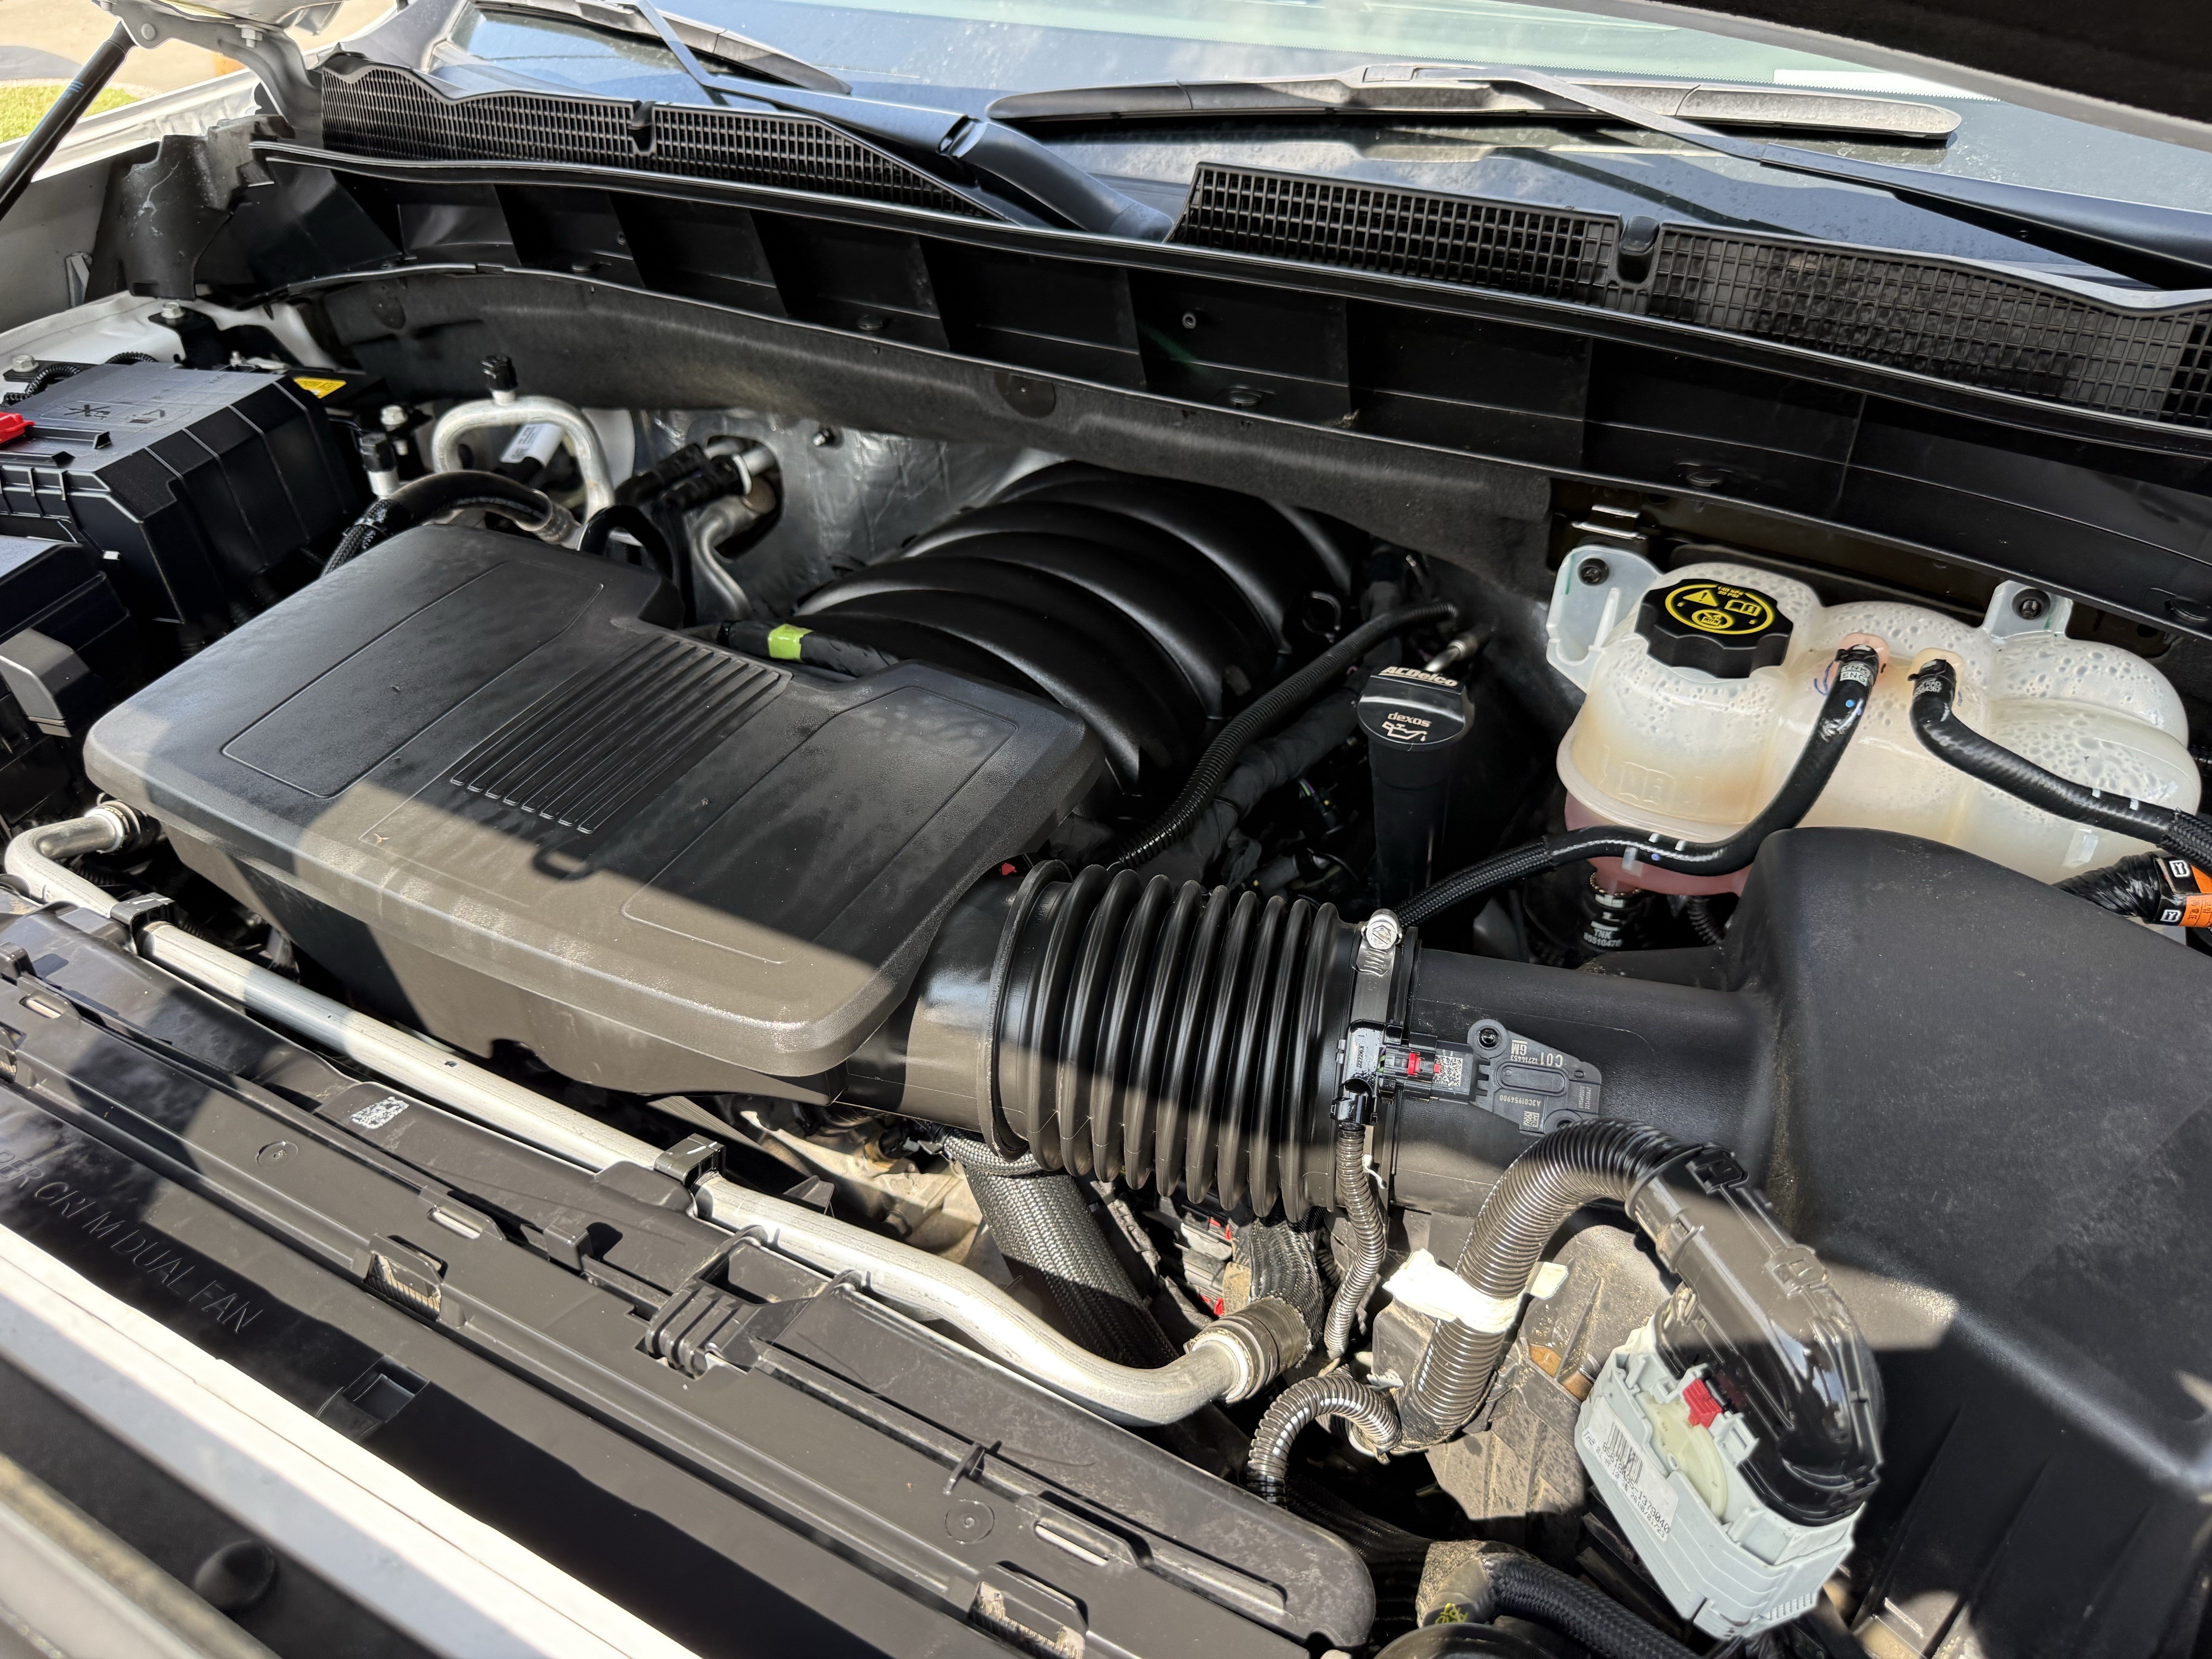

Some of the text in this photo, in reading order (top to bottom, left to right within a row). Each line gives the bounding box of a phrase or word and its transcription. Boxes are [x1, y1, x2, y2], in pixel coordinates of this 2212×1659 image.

[1379, 666, 1458, 687] ACDelco
[1843, 673, 1865, 682] ENG
[1388, 712, 1432, 728] dexos
[1511, 1042, 1527, 1056] GM
[1540, 1052, 1563, 1068] C01
[112, 1229, 195, 1295] DUAL
[189, 1279, 263, 1333] FAN
